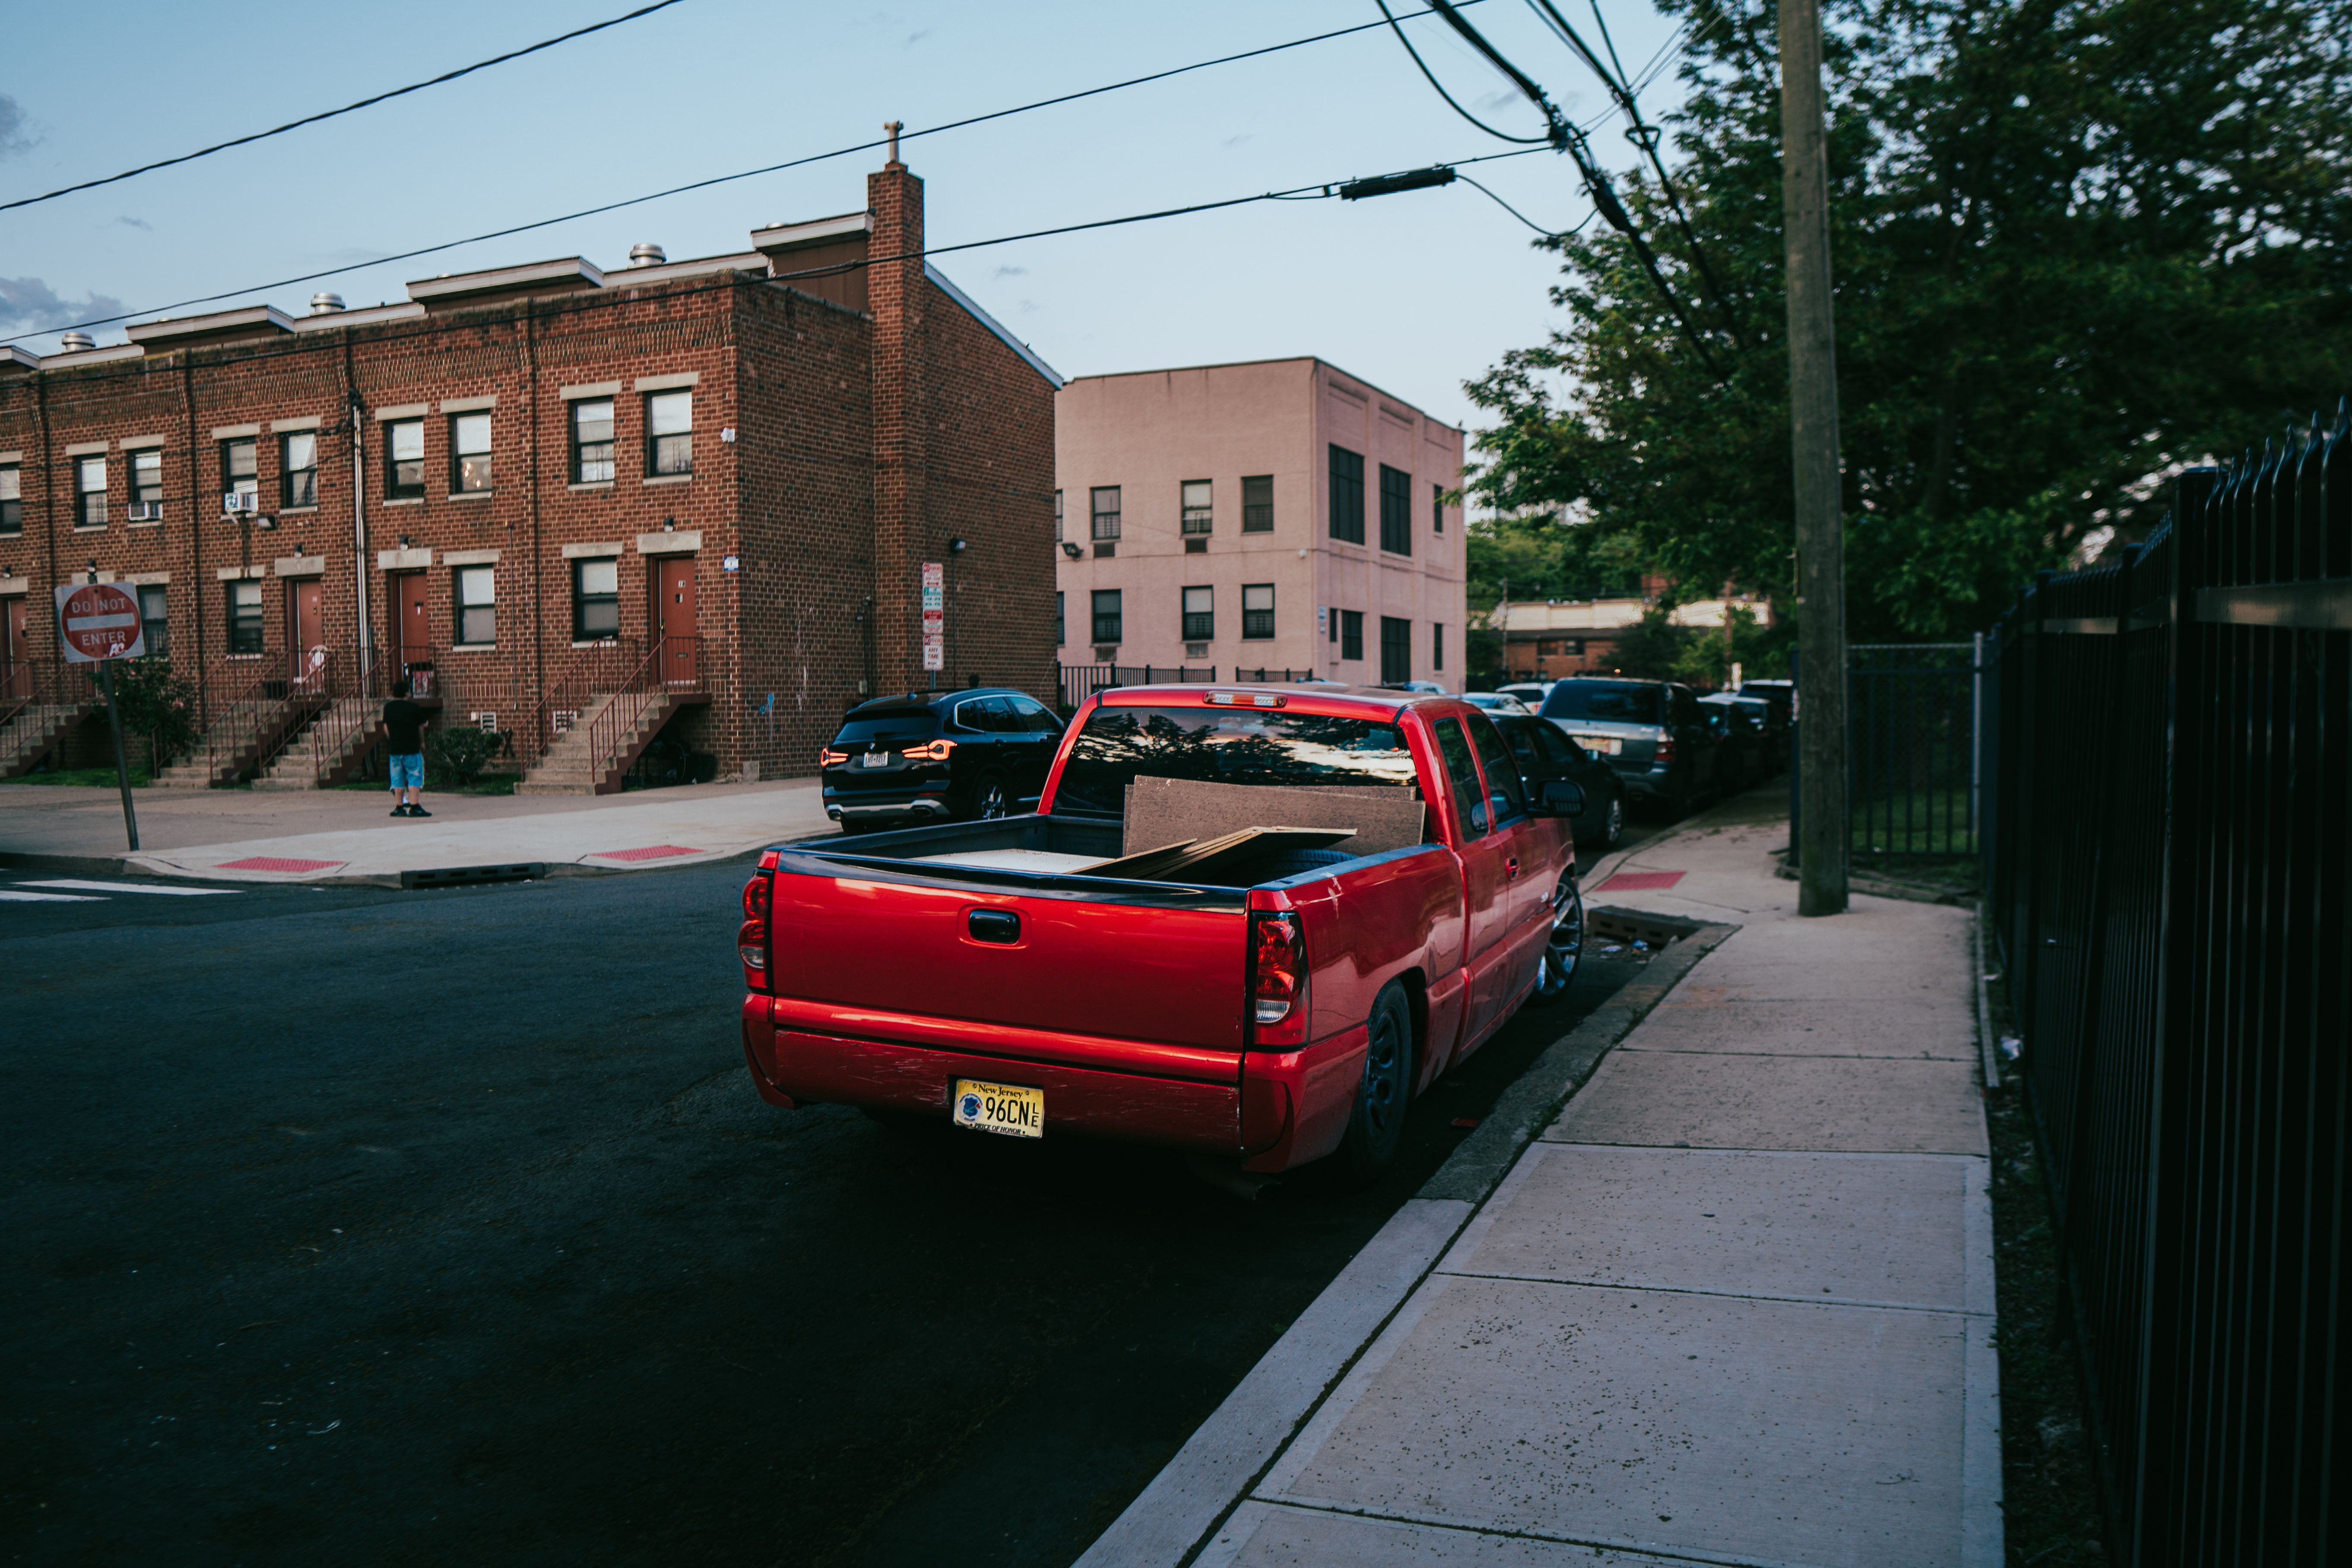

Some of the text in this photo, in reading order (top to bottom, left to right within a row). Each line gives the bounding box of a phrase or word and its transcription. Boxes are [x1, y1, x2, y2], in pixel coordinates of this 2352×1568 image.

[72, 597, 125, 613] DO NOT
[82, 630, 126, 646] ENTER
[978, 1084, 1023, 1099] New Jersey
[986, 1096, 1030, 1126] 96CN
